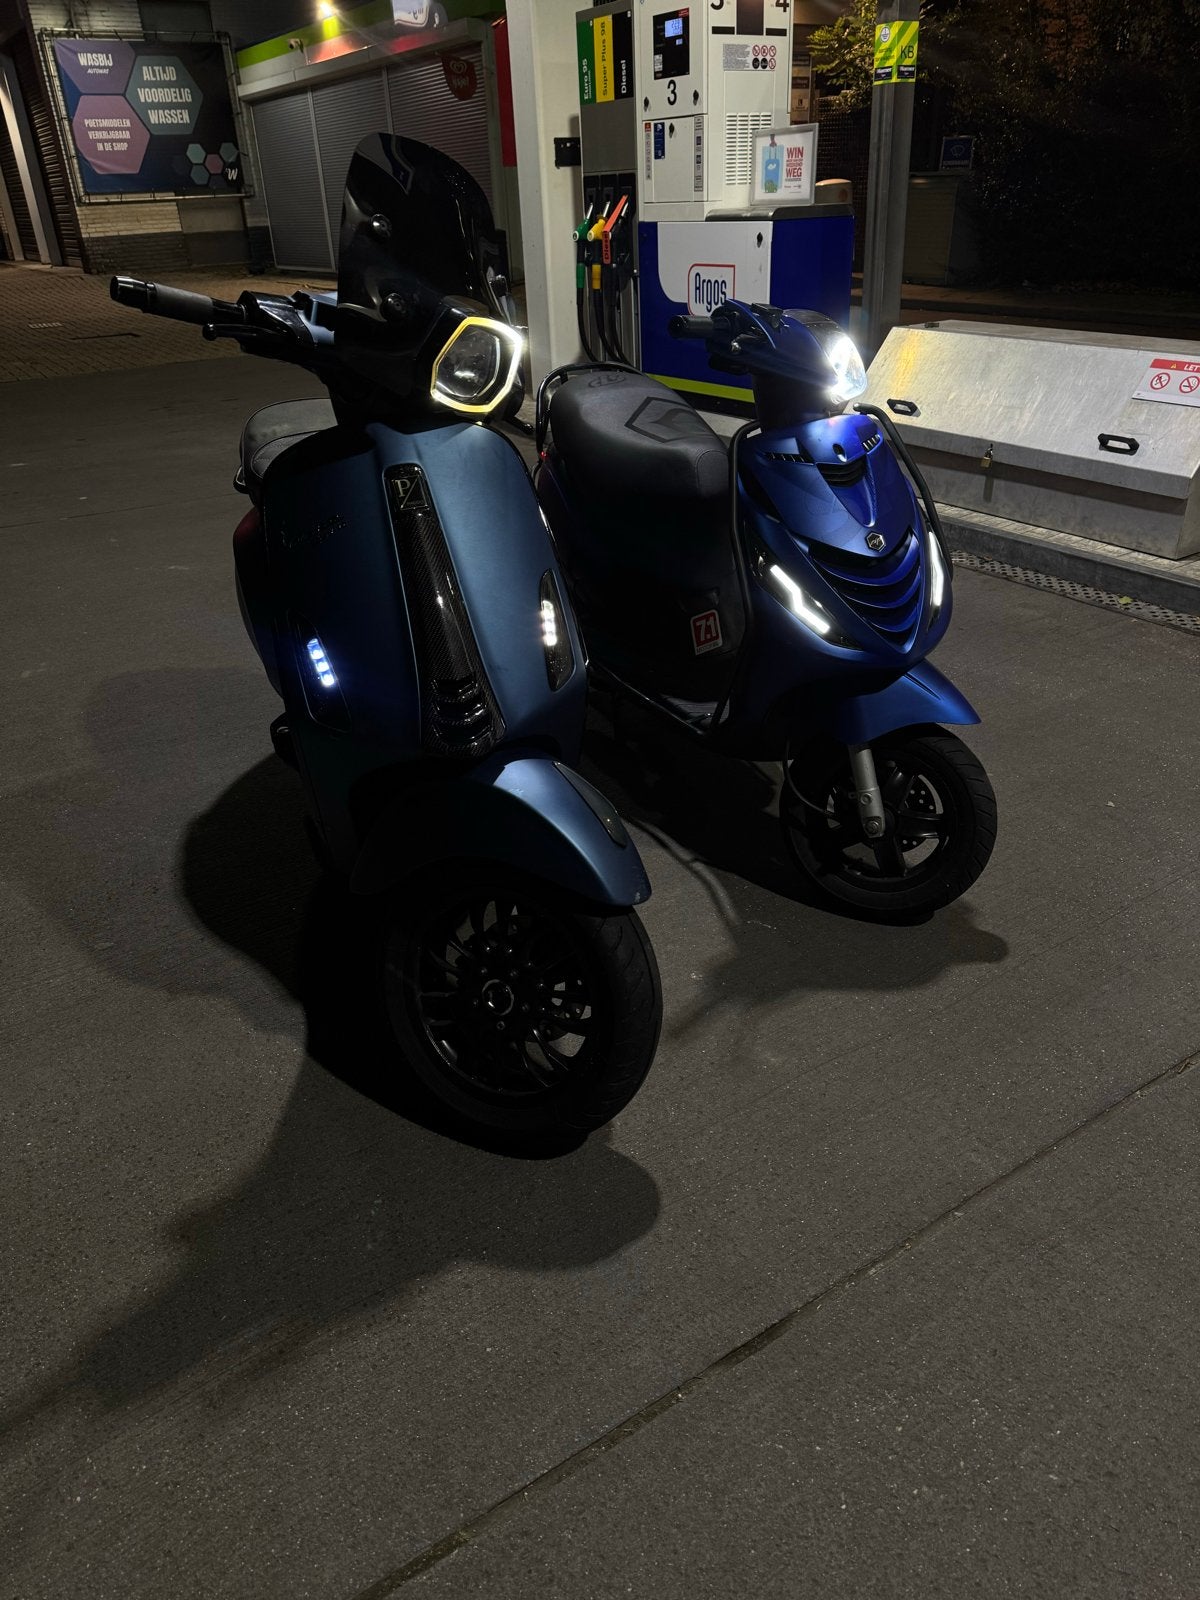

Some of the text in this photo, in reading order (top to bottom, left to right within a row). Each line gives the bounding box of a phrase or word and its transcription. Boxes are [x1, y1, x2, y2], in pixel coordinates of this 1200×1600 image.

[600, 21, 606, 36] 98
[900, 45, 915, 59] KB
[77, 53, 114, 67] WASBIJ
[582, 58, 588, 73] 95
[142, 66, 177, 81] ALTIJD
[137, 87, 192, 103] VOORDELIG
[667, 79, 677, 106] 3
[84, 118, 131, 128] POETSMIDDELEN
[147, 109, 190, 124] WASSEN
[87, 130, 131, 139] VERKRIJGBAAR
[96, 142, 128, 151] IN DE SHOP
[786, 146, 804, 159] WIN
[785, 167, 802, 178] WEG
[694, 271, 727, 313] Argos
[1183, 363, 1199, 372] LET
